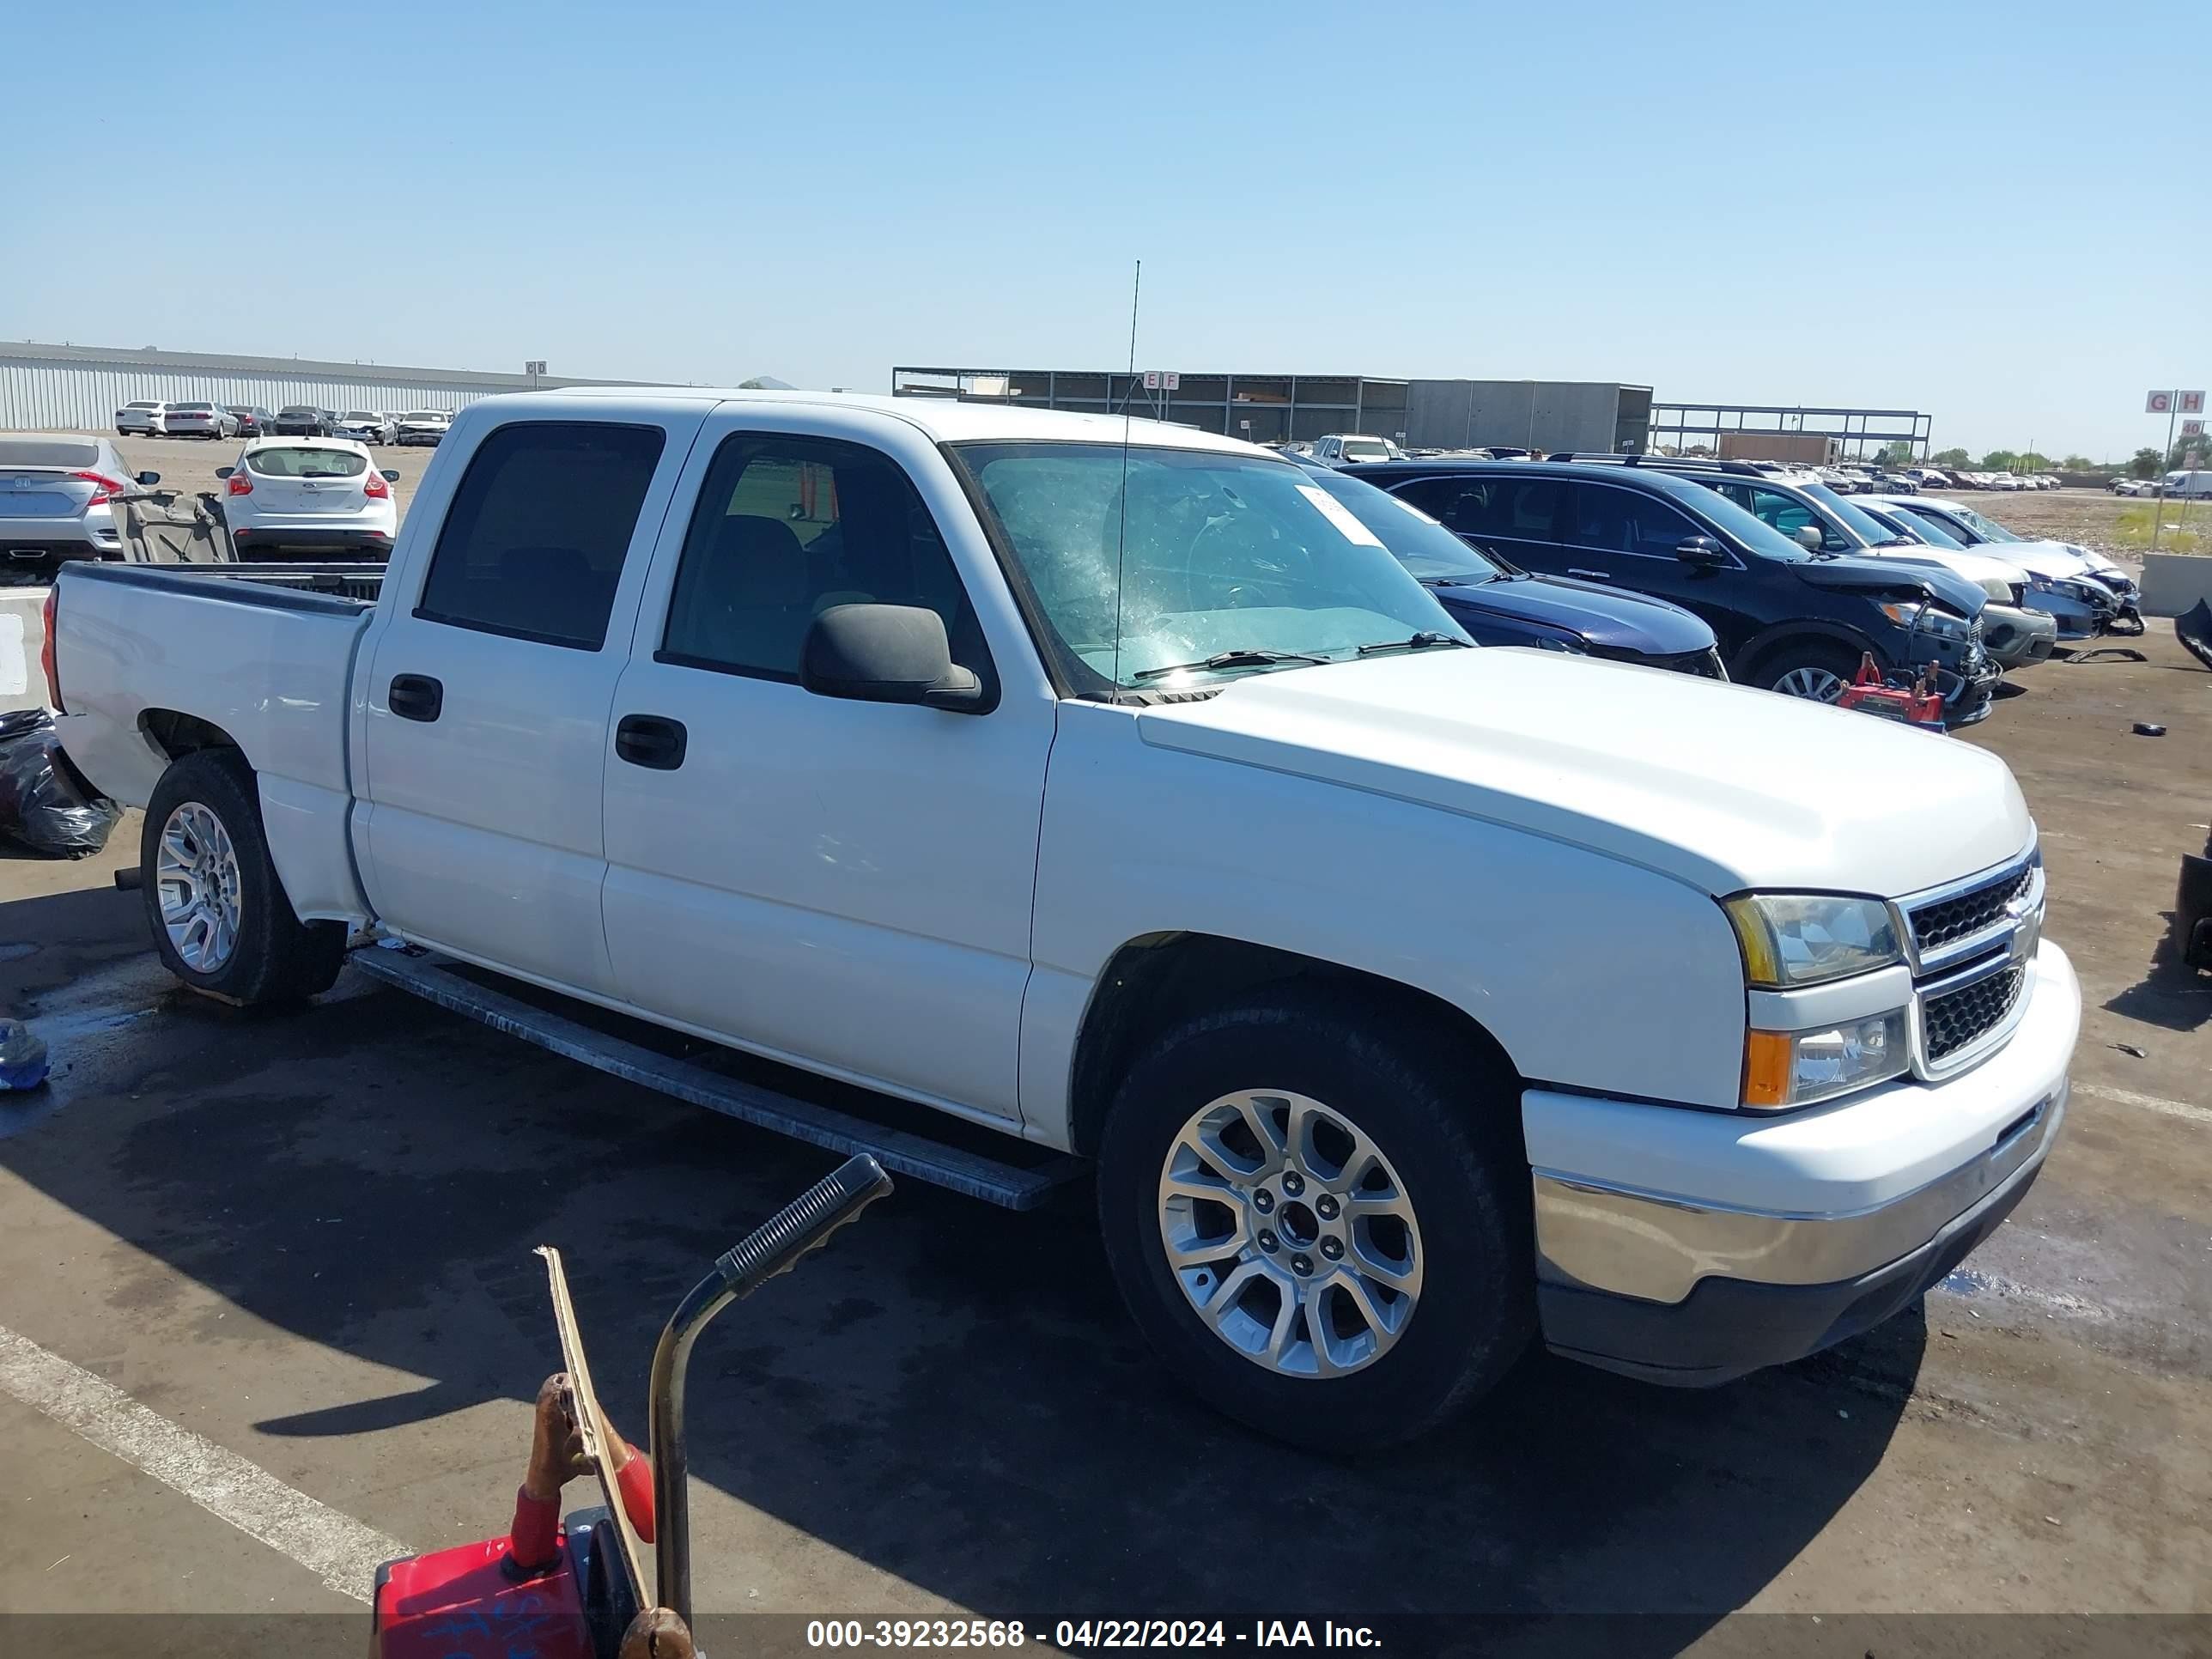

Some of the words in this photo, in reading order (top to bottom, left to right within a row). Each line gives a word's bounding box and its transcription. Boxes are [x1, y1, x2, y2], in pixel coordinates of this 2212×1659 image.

[1148, 374, 1156, 386] E
[1168, 374, 1176, 387] F
[2150, 394, 2167, 410] G
[2184, 393, 2199, 410] H
[2184, 423, 2199, 434] 40
